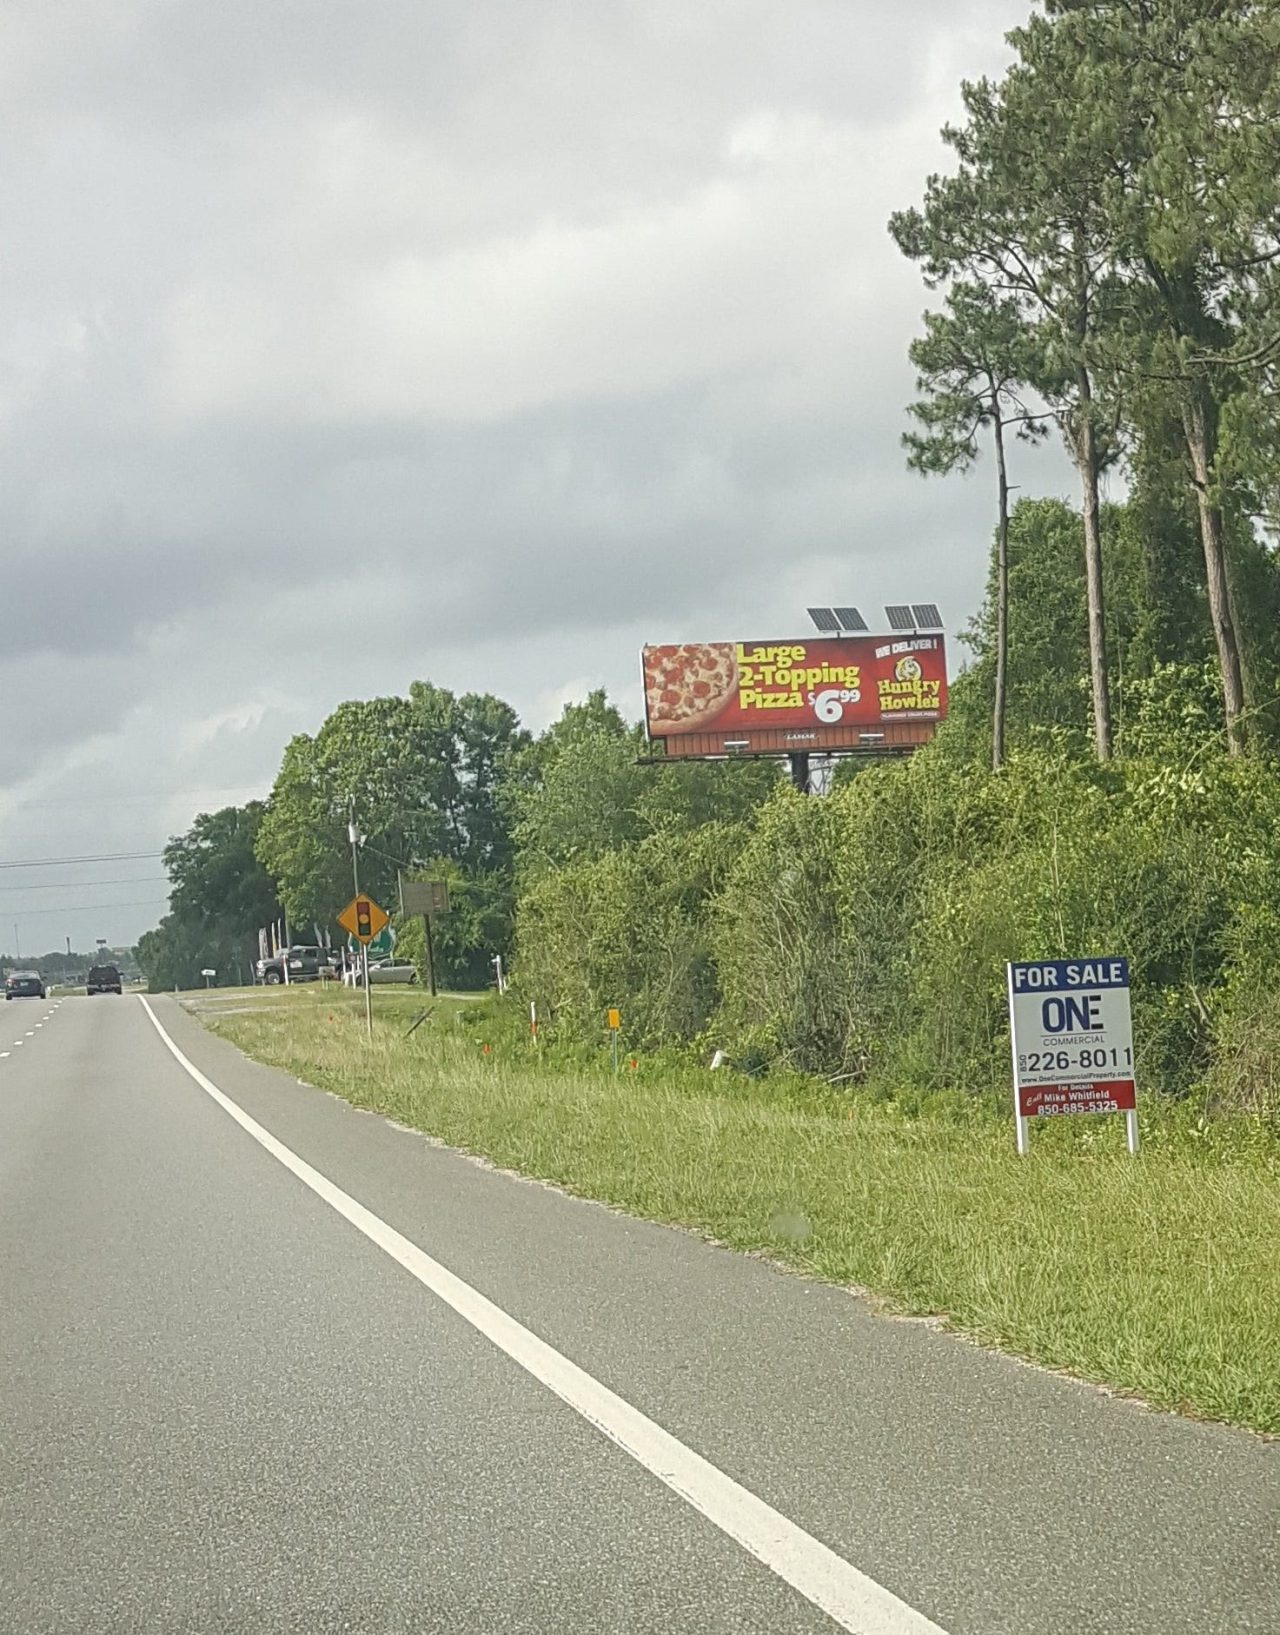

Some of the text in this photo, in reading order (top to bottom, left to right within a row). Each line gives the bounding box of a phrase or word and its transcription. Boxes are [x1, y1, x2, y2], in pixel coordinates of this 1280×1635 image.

[736, 643, 806, 668] Large
[738, 662, 861, 690] 2-Topping
[877, 679, 940, 696] Hungry
[739, 688, 804, 709] Pizza
[1015, 963, 1123, 988] FOR SALE
[1042, 995, 1104, 1033] ONE
[1043, 1036, 1105, 1047] COMMERCIAL
[1019, 1055, 1027, 1072] 850
[1028, 1047, 1132, 1072] 226-8011
[1044, 1090, 1110, 1103] Mike Whitfield
[1071, 1083, 1094, 1091] Details
[1038, 1100, 1118, 1115] 850-685-5325
